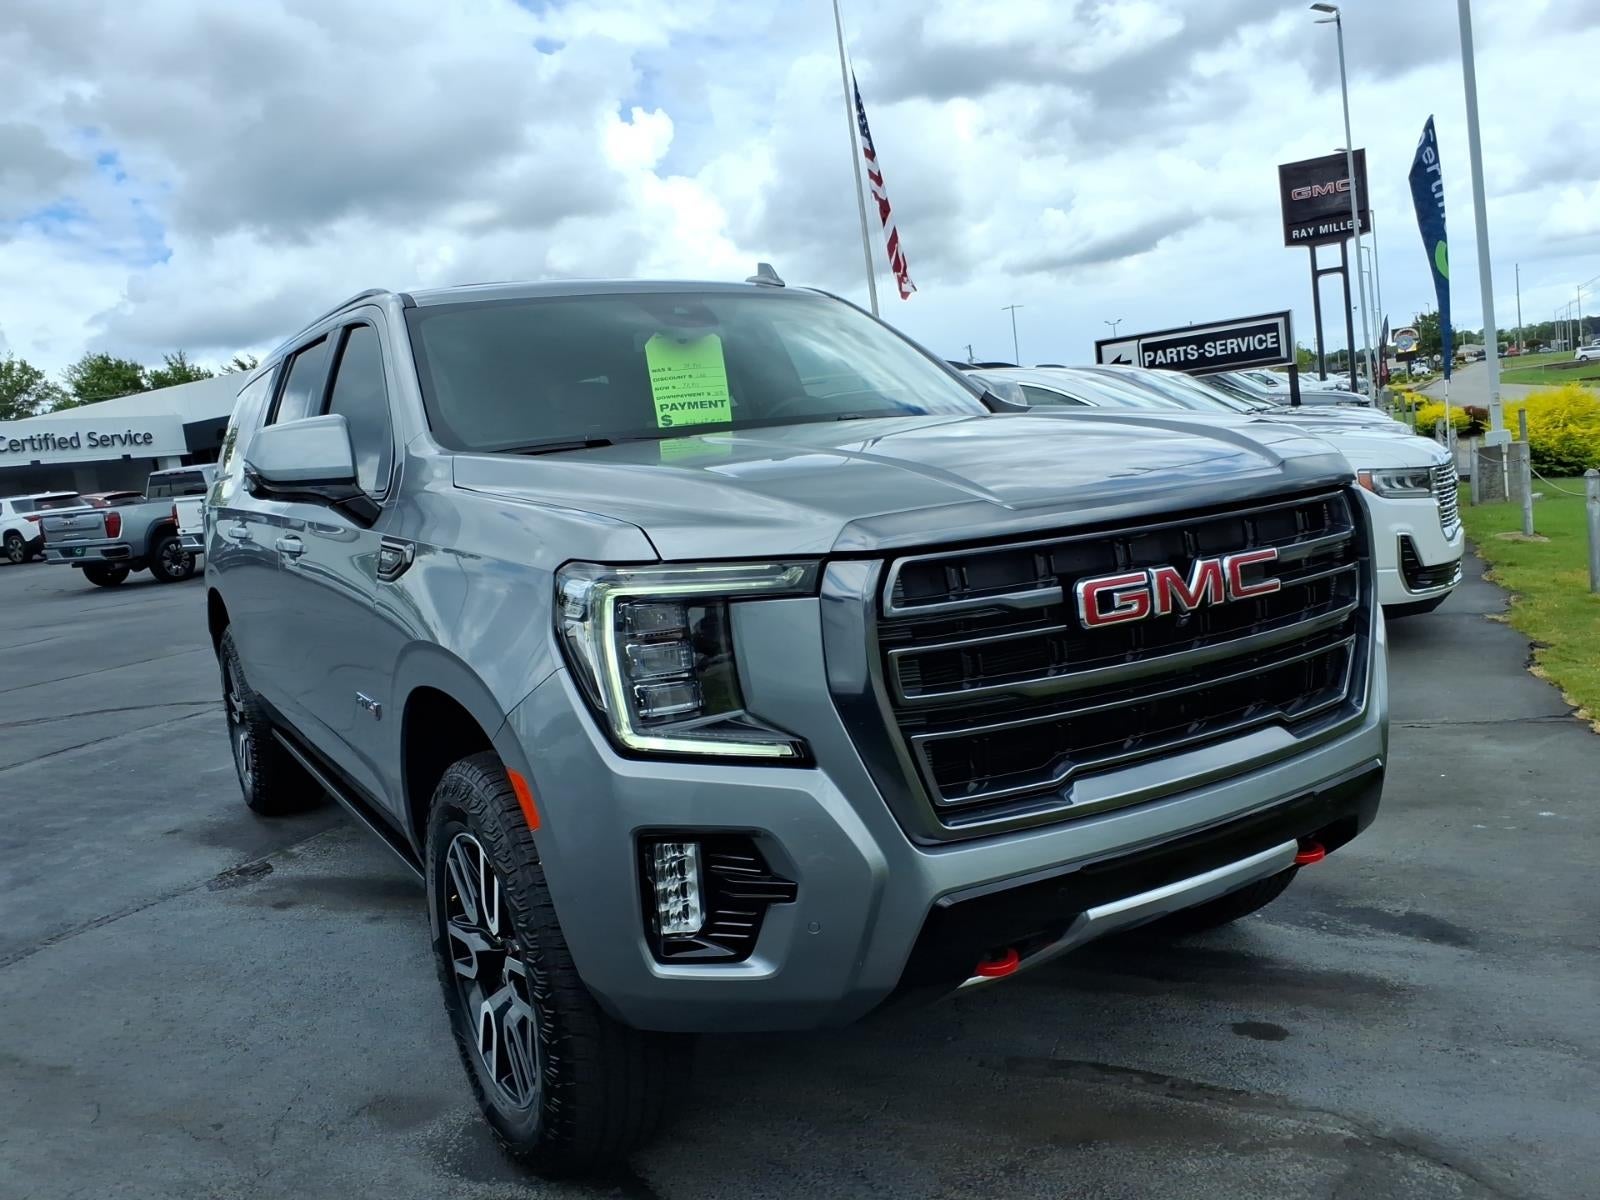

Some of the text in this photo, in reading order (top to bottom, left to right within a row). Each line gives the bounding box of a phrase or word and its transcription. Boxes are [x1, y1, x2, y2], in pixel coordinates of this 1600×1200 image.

[1291, 178, 1355, 201] GMC
[1292, 227, 1315, 239] RAY
[1143, 332, 1278, 367] PARTS-SERVICE
[660, 400, 726, 412] PAYMENT
[661, 414, 673, 426] $
[87, 429, 153, 448] Service
[1076, 547, 1281, 629] GMC
